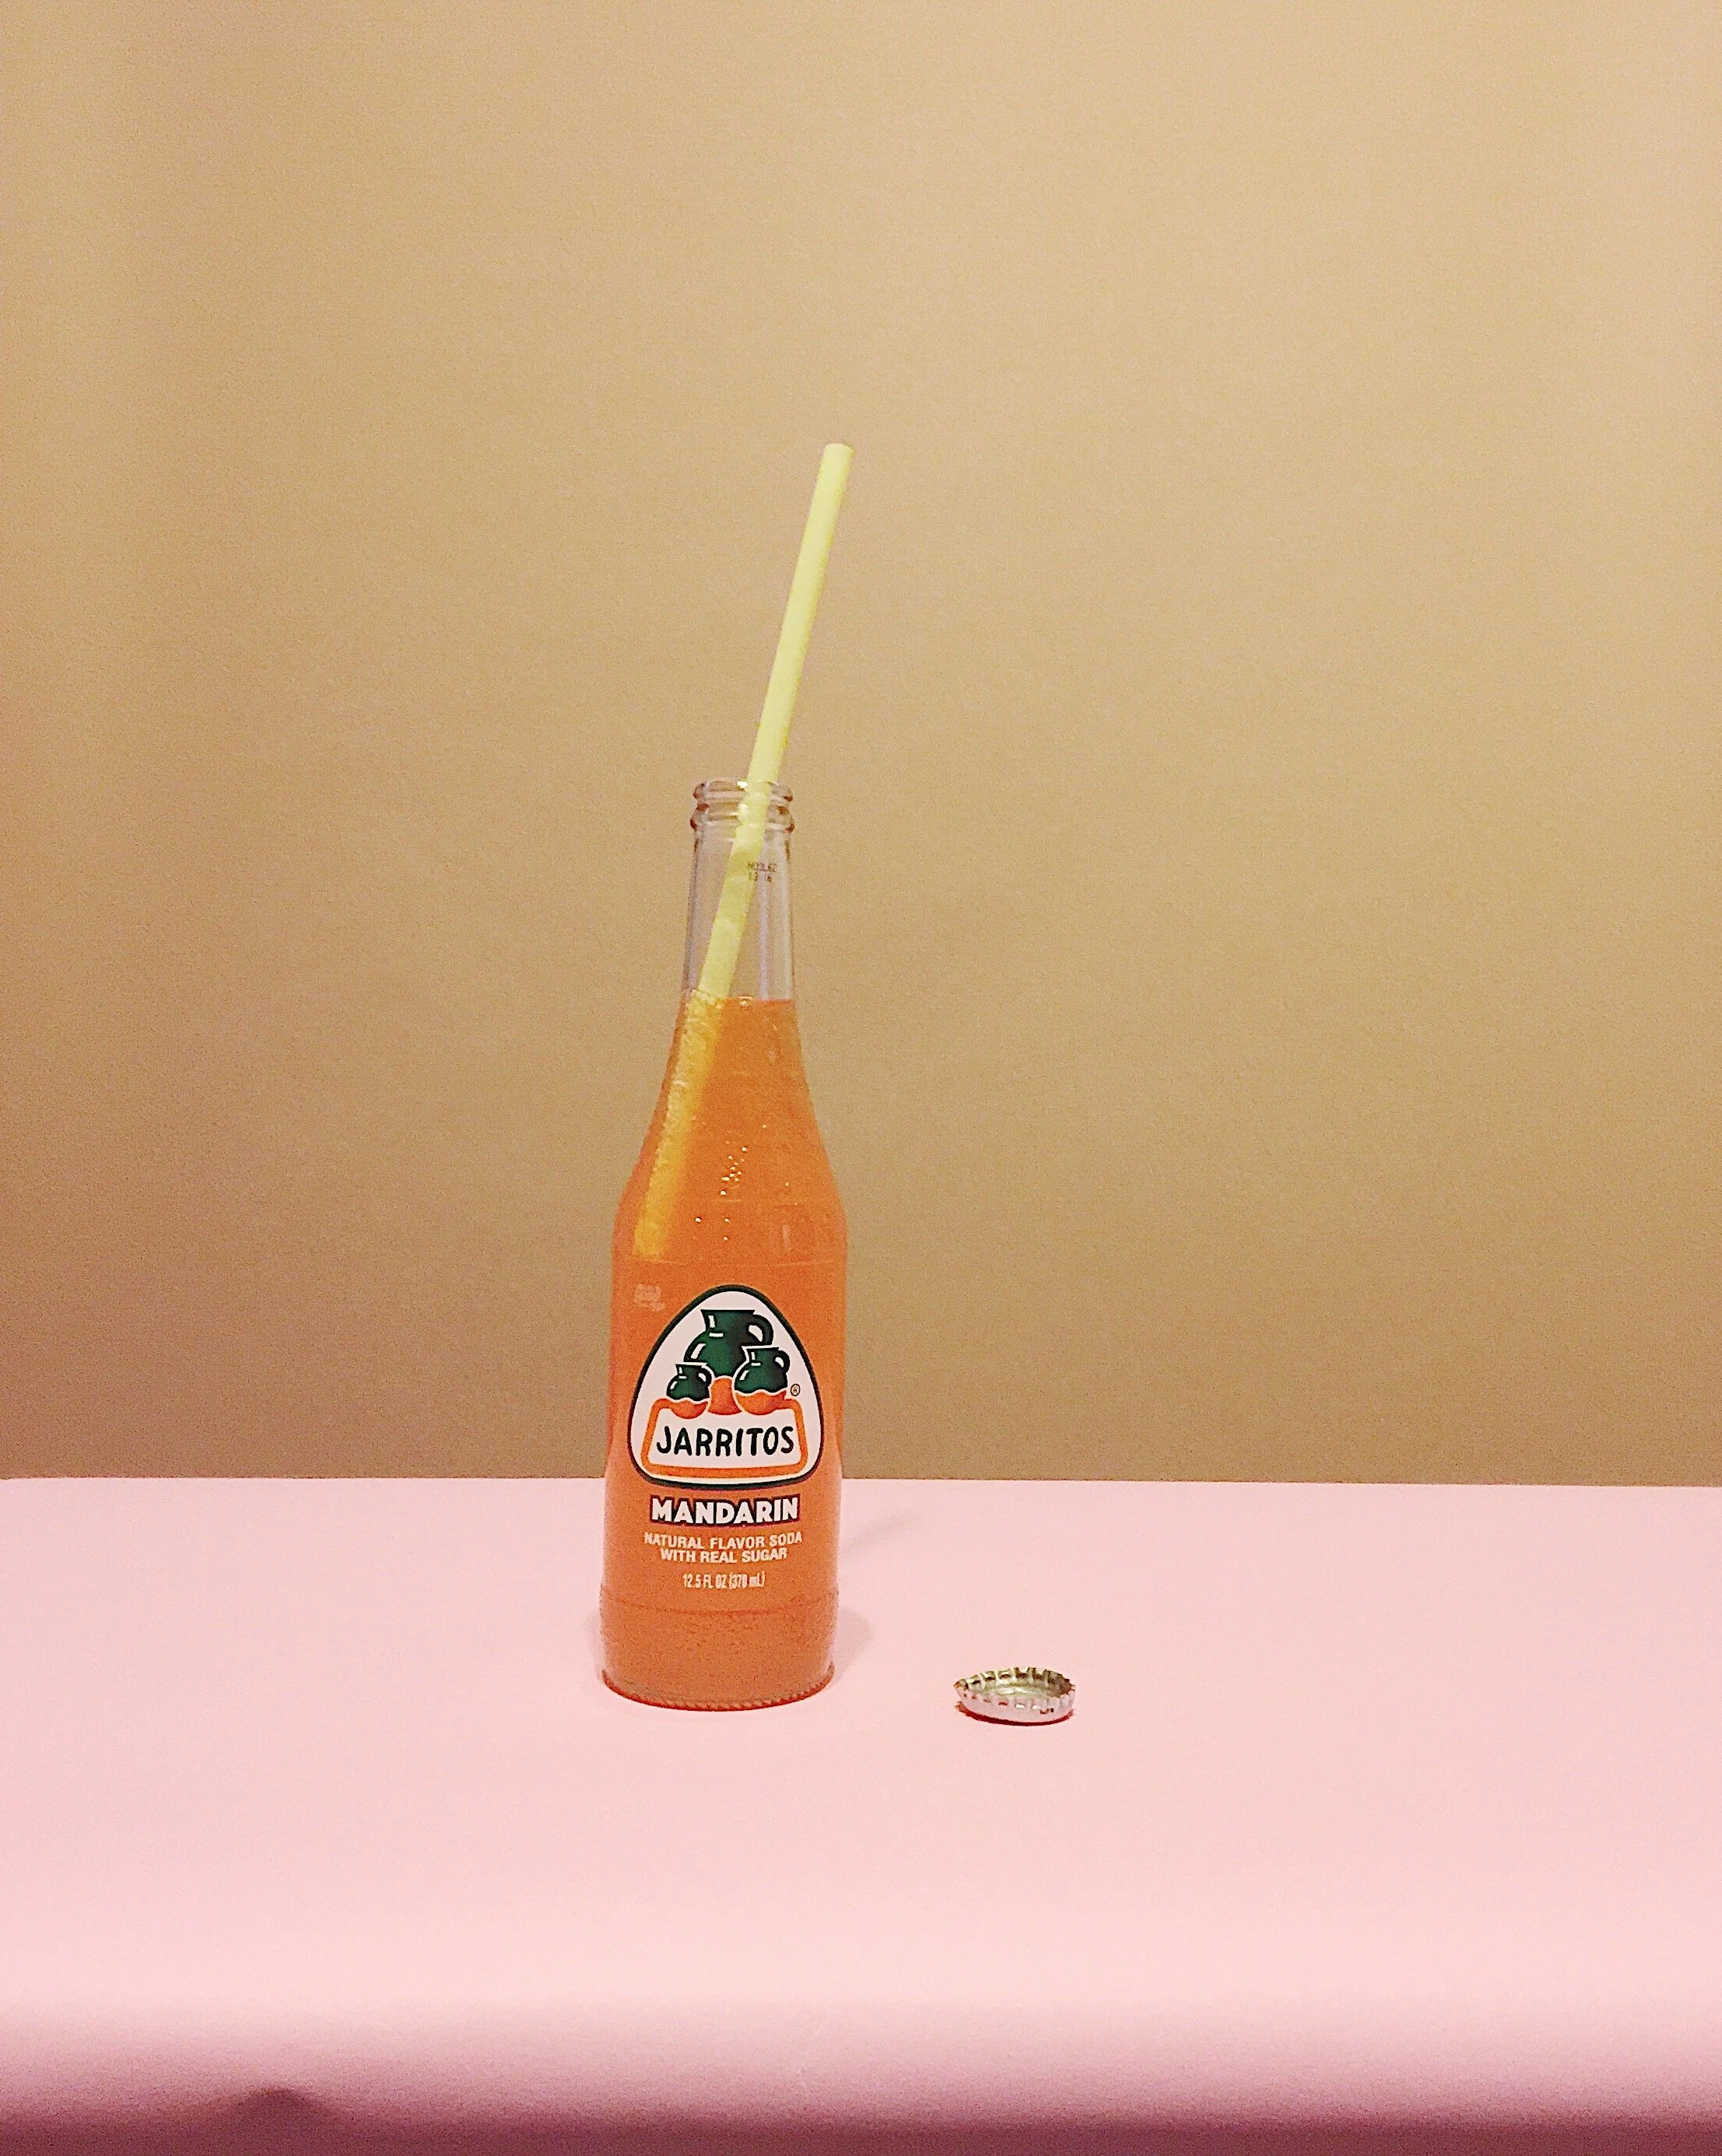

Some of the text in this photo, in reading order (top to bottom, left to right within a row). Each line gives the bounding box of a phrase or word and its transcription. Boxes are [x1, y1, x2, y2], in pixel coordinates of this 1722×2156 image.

[656, 1425, 794, 1457] JARRITOS
[652, 1497, 798, 1525] MANDARIN
[644, 1531, 803, 1550] NATURAL FLAVOR SODA
[661, 1547, 787, 1564] WITH REAL SUGAR
[682, 1569, 766, 1590] 12.5 FL OZ (370 mL)
